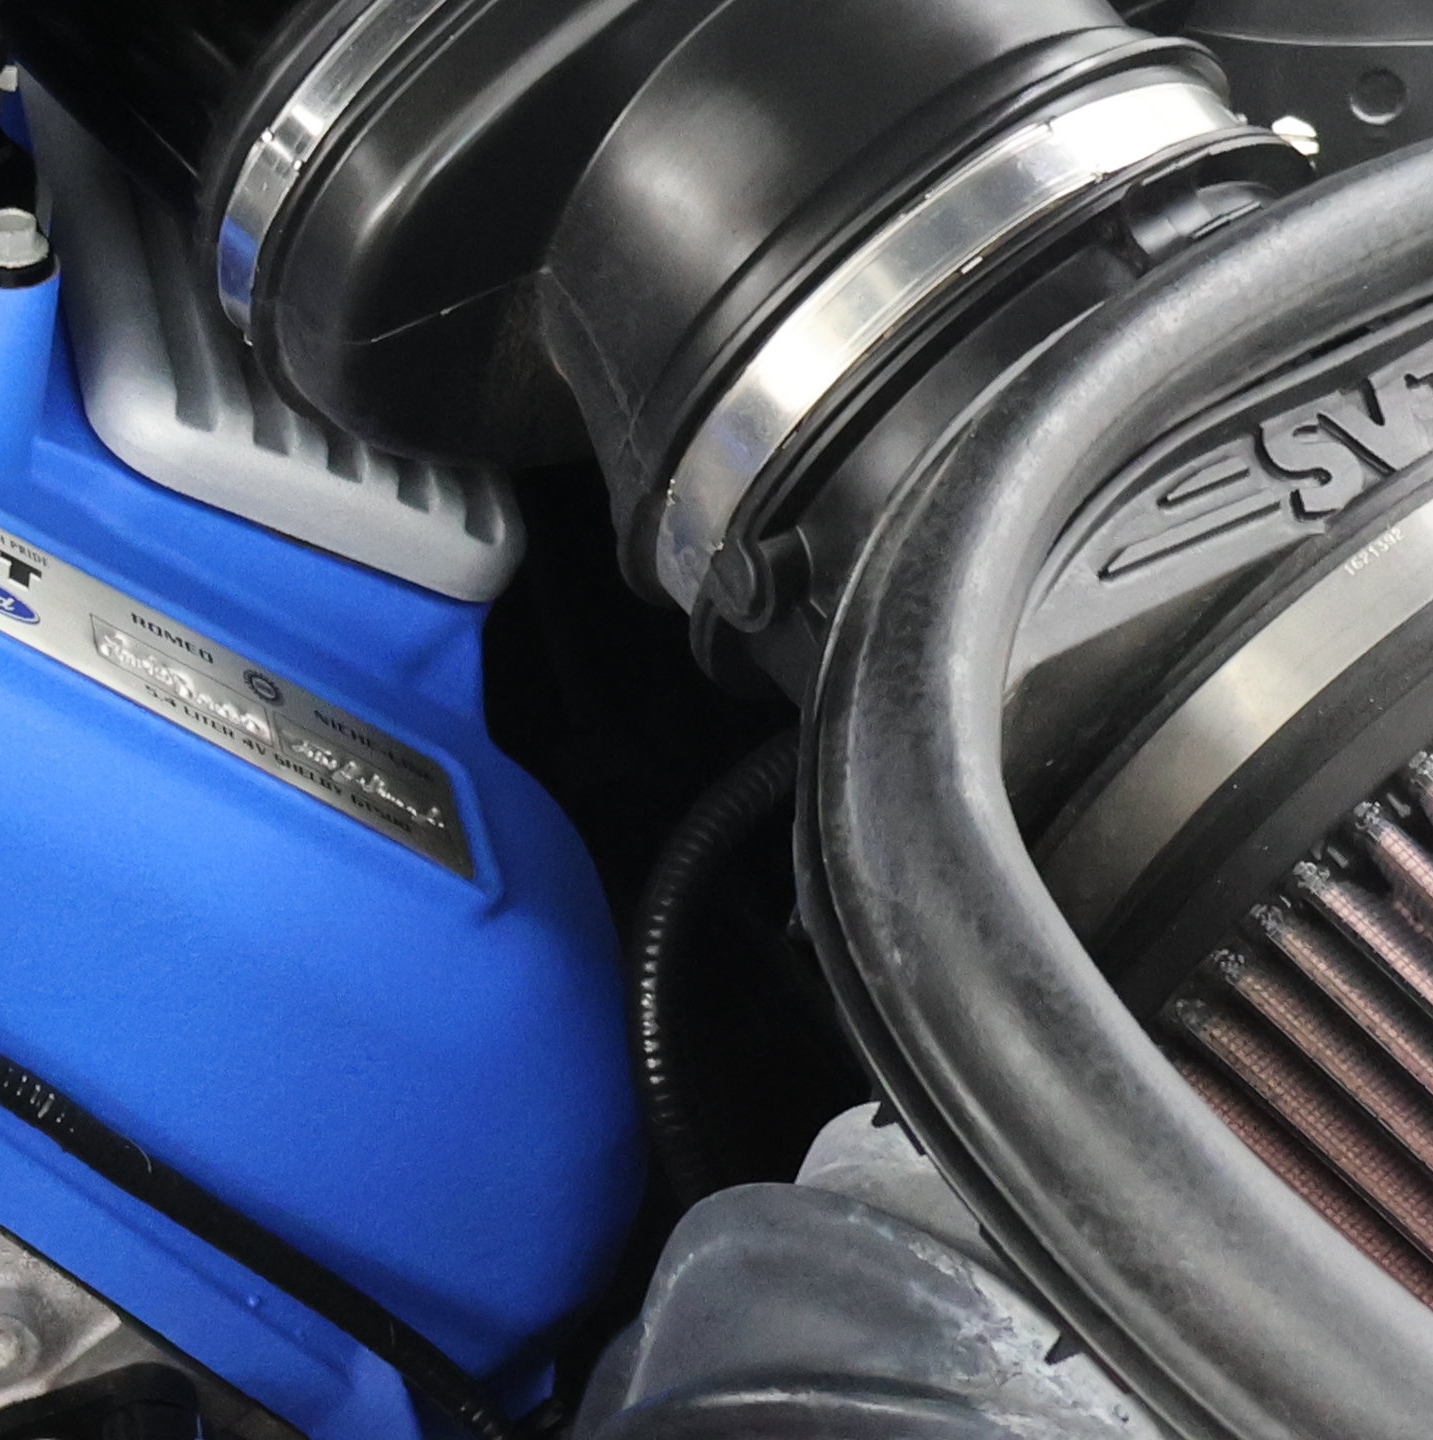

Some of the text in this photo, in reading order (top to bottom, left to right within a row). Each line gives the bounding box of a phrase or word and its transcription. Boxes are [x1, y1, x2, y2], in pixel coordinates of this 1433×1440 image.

[10, 541, 49, 567] PRIDE
[131, 612, 214, 664] ROMEO
[145, 684, 177, 708] 5.4
[184, 706, 236, 740] LITER
